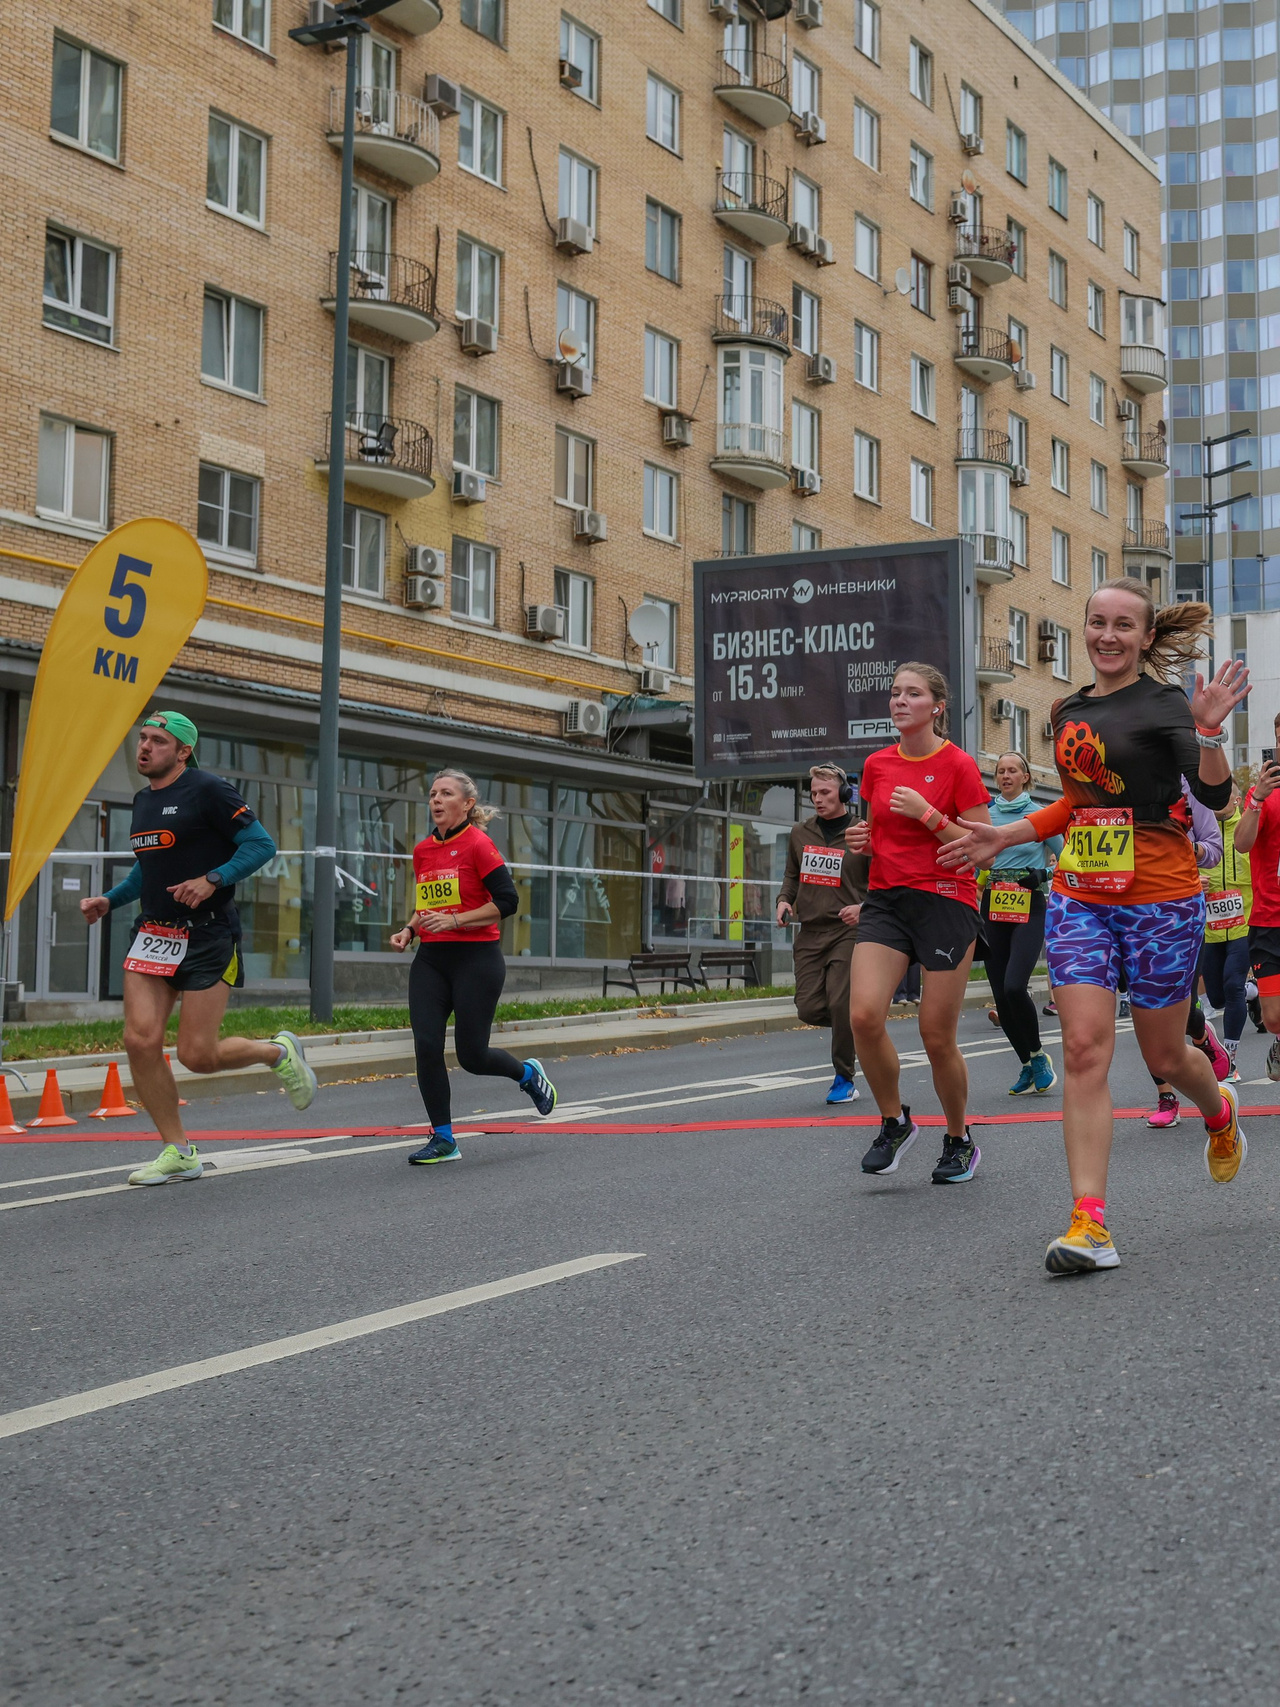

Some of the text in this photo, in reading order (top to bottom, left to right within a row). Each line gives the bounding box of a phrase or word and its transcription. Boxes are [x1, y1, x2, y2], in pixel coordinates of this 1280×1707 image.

[104, 553, 153, 639] 5
[711, 586, 789, 605] MYPRIORITY
[817, 578, 896, 596] МНЕВНИКИ
[713, 621, 875, 660] БИЗНЕС-КЛАСС
[847, 660, 897, 678] ВИДОВЫЕ
[726, 662, 778, 701] 15.3
[780, 686, 798, 698] МЛН
[771, 727, 827, 739] WWW.GRANELLE.RU
[1095, 818, 1107, 826] 10
[1070, 830, 1130, 857] 15147
[804, 854, 841, 871] 16705
[1076, 860, 1110, 868] СВЕТЛАНА
[420, 881, 453, 900] 3188
[994, 892, 1026, 907] 6294
[1206, 898, 1242, 915] 15805
[141, 936, 182, 957] 9270
